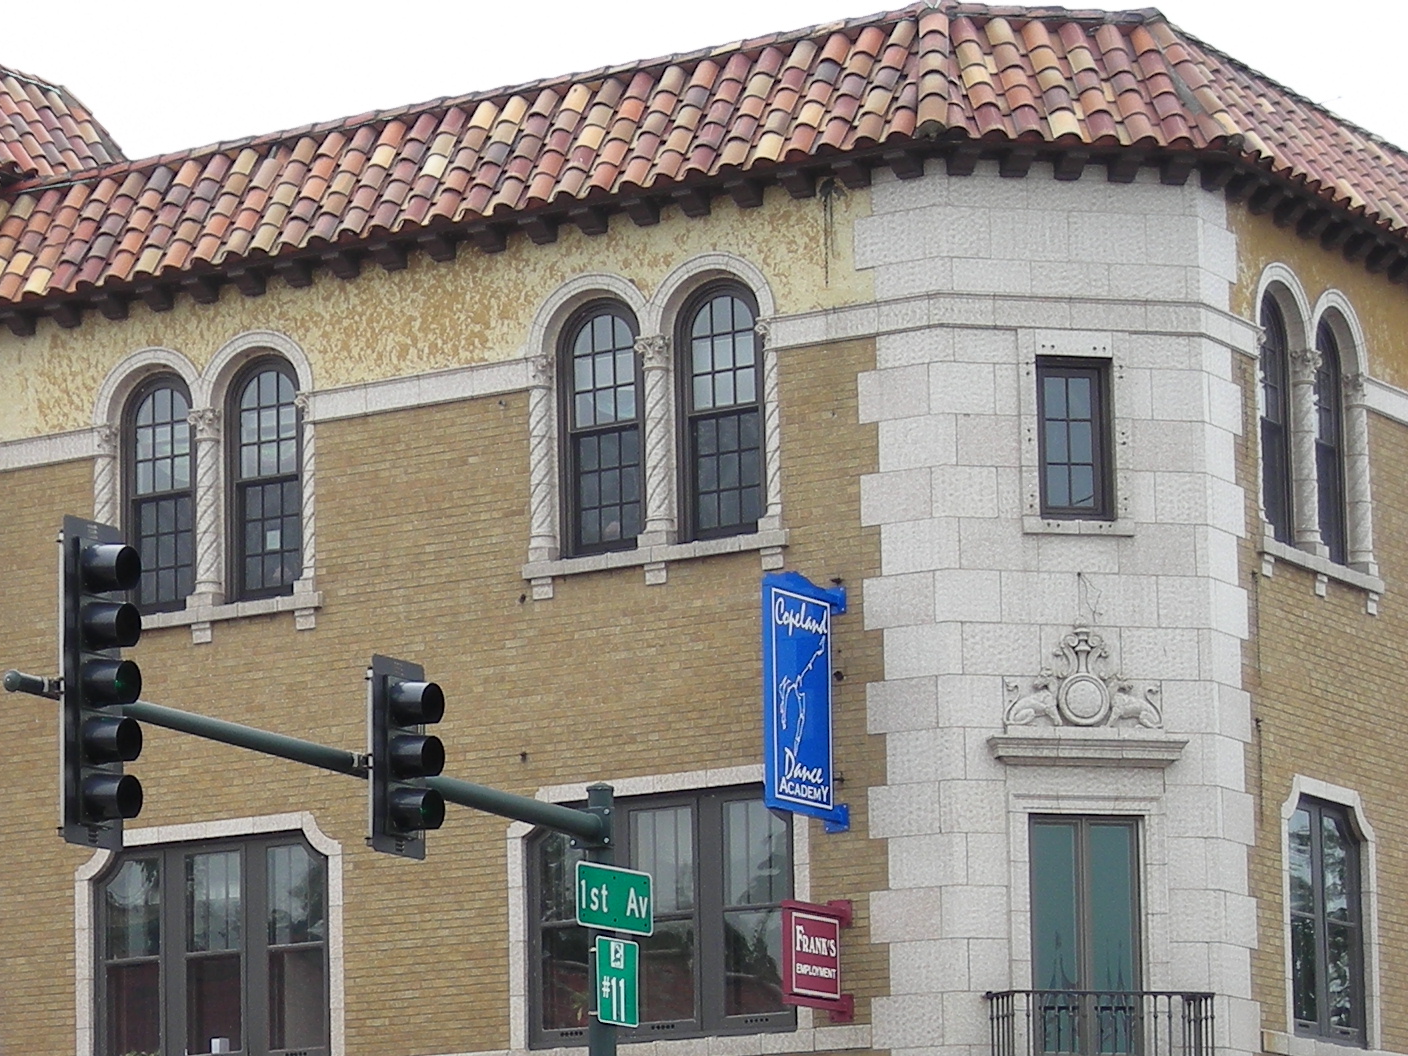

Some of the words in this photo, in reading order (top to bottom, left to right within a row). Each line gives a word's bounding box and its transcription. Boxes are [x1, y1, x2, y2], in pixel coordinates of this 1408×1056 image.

[775, 596, 828, 636] Copeland
[784, 747, 824, 784] Dance
[779, 776, 830, 803] ACADEMY
[580, 879, 609, 914] 1st
[626, 887, 649, 919] Av
[795, 924, 837, 957] FRANK'S
[795, 962, 837, 979] EMPLOYMENT
[601, 975, 626, 1023] #11
